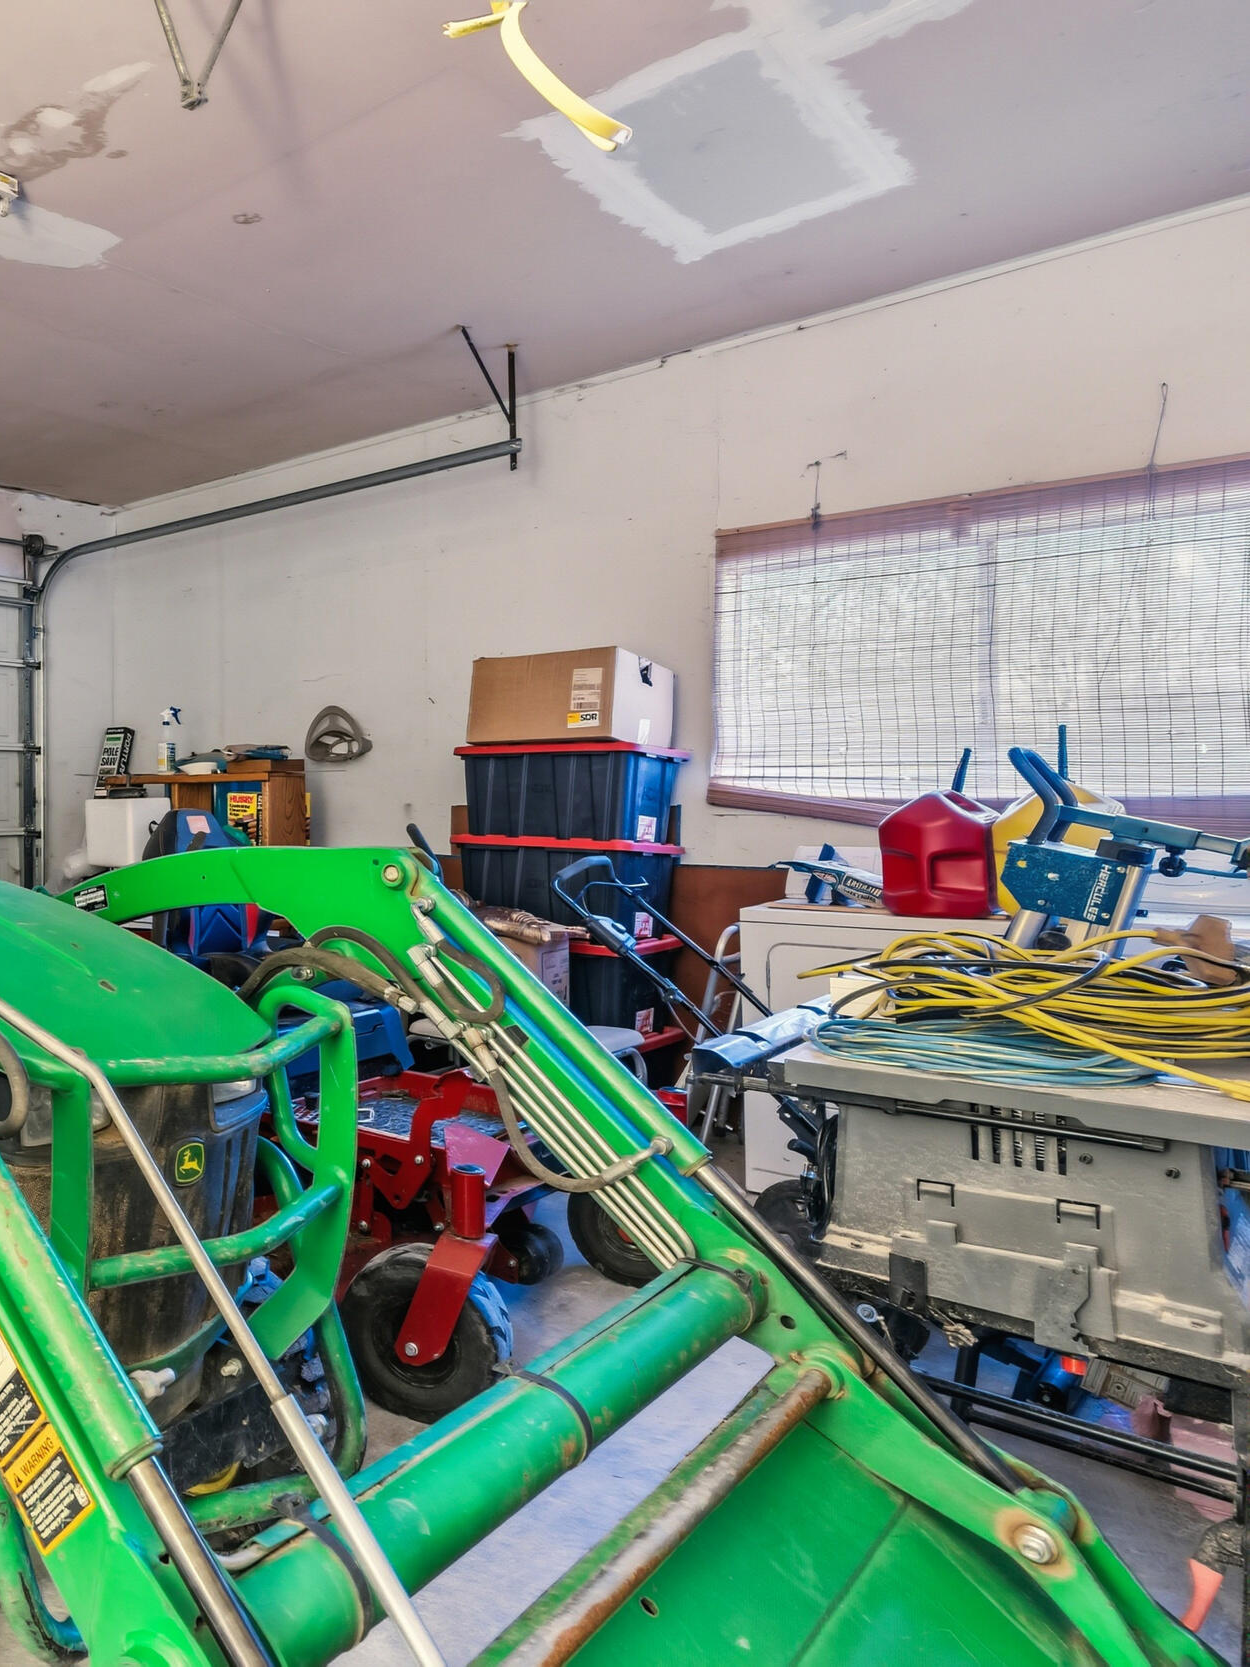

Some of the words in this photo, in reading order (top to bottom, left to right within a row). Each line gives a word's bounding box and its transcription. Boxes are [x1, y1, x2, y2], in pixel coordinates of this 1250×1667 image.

[100, 756, 118, 766] SAW
[102, 746, 120, 757] POLE
[1086, 864, 1112, 921] HERCULES
[20, 1437, 54, 1477] WARNING
